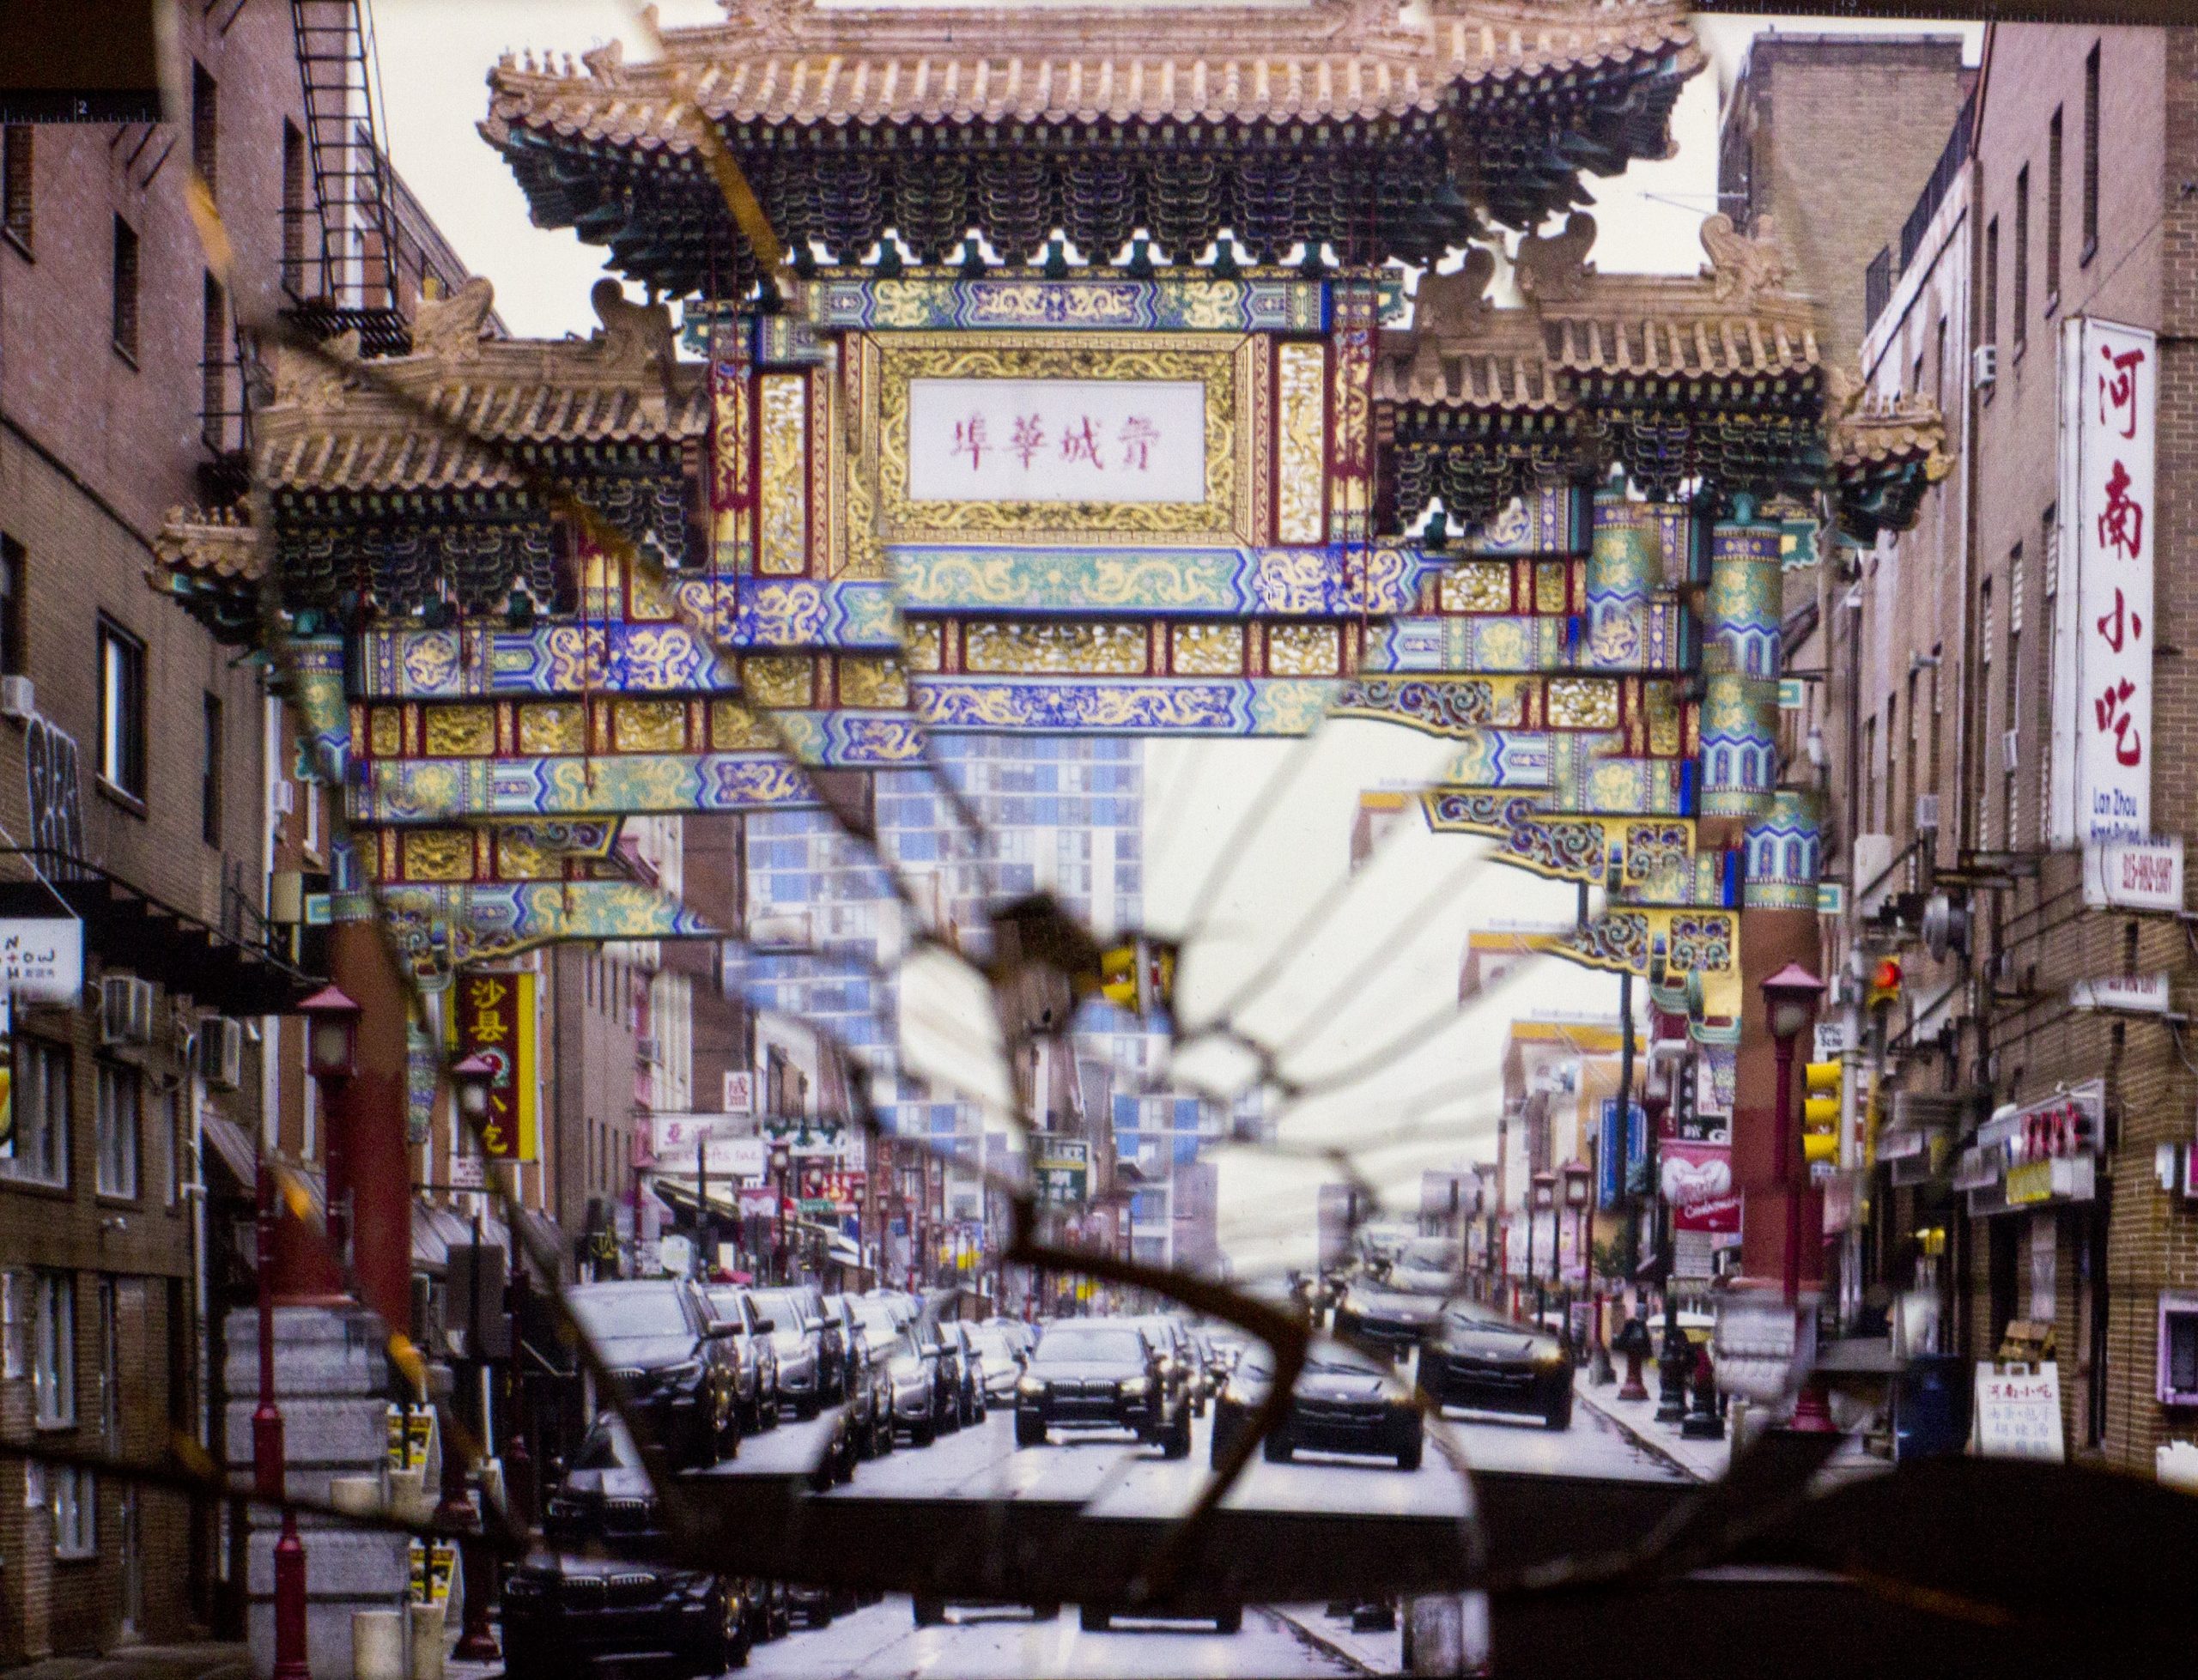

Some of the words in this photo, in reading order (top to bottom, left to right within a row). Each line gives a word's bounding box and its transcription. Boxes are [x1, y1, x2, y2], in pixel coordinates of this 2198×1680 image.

[78, 100, 88, 114] 2
[2095, 343, 2146, 767] 河南小吃
